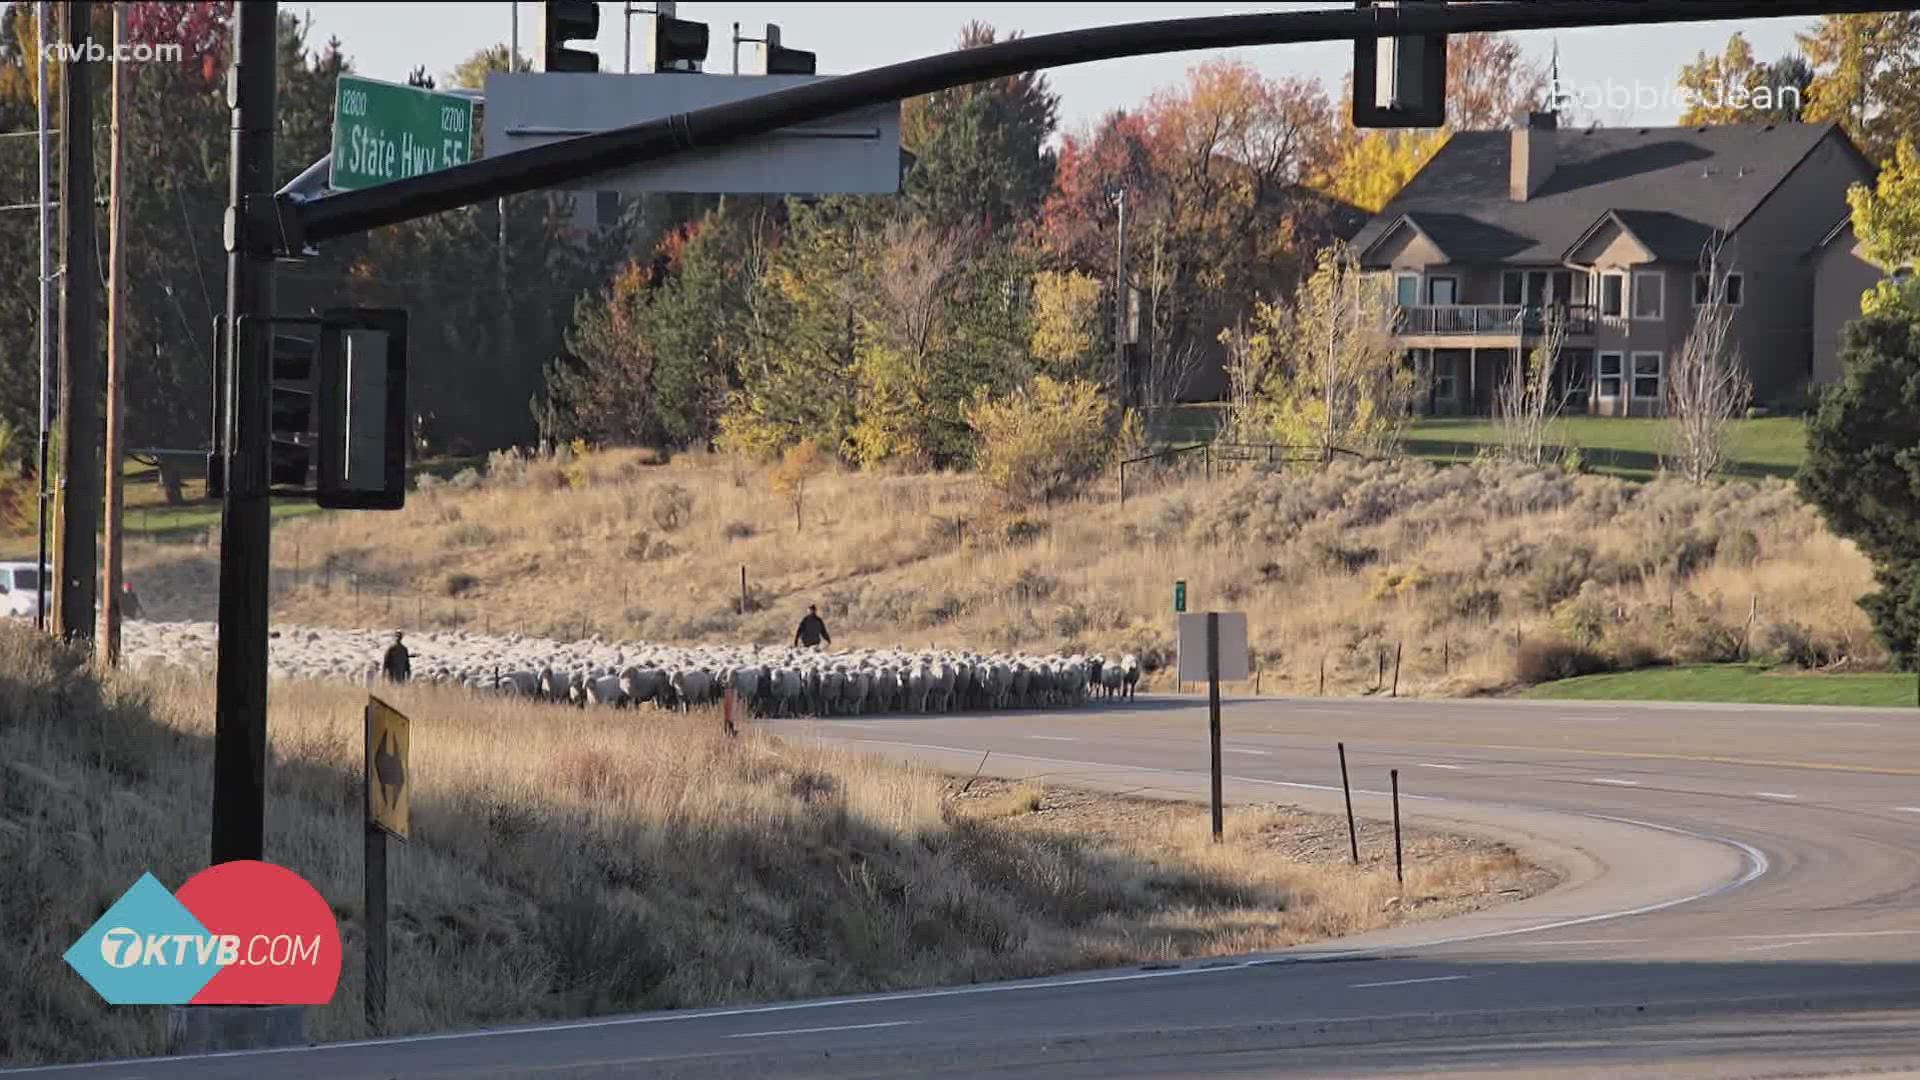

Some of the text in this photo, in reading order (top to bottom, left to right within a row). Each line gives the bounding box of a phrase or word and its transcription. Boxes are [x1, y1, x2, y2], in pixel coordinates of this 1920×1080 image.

[342, 89, 367, 117] 12800
[441, 107, 465, 133] 12700
[349, 124, 395, 178] State
